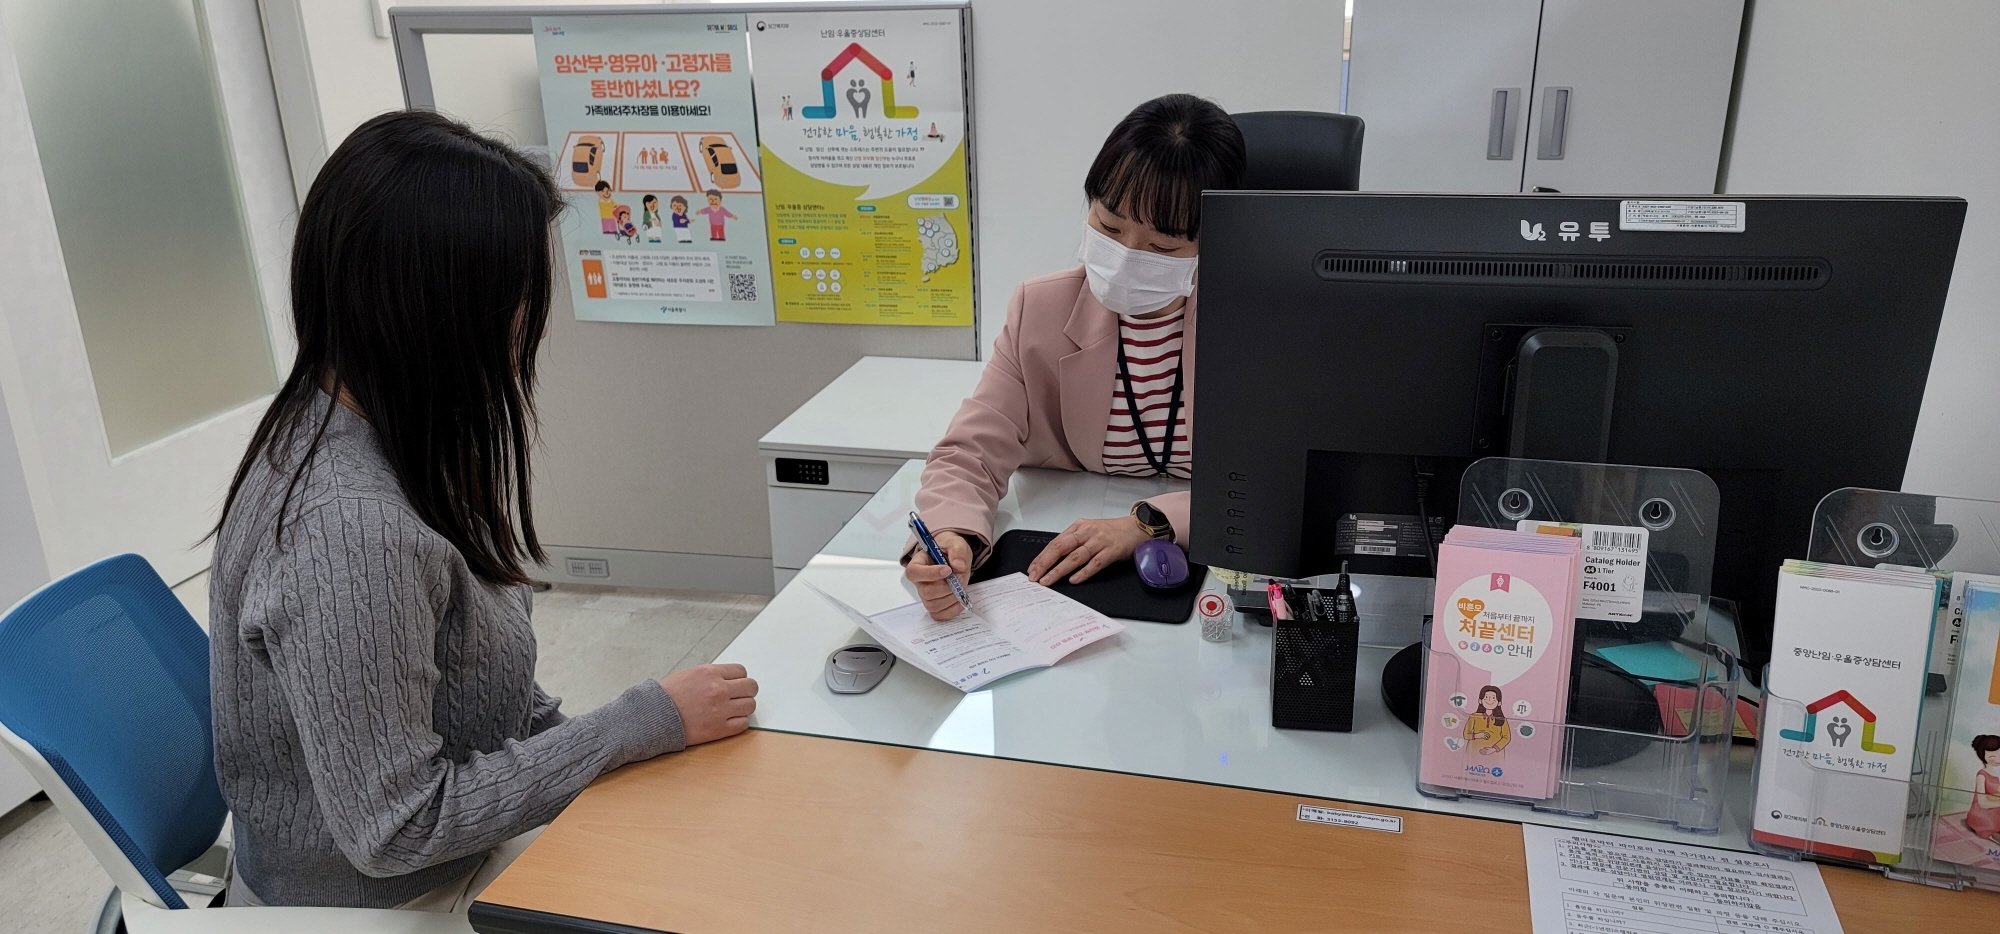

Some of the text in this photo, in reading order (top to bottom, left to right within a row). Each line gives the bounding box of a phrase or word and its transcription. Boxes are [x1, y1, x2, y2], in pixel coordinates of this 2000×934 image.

[554, 53, 658, 73] 임산부·영유아
[590, 80, 700, 98] 동반하셨나요?
[584, 105, 712, 116] 가족배려주차장을 이용하세요!
[802, 125, 918, 142] 건강한 마음, 행복한 가정
[1558, 221, 1611, 242] 유투
[1586, 556, 1641, 566] Catalog Holder
[1583, 581, 1616, 592] F4001
[1483, 611, 1535, 623] 처음부터 끝까지
[1459, 619, 1534, 643] 처끝센터
[1508, 644, 1532, 658] 안내
[1793, 646, 1901, 670] 중앙난임·우울증상담센터
[1783, 748, 1809, 760] 건강한
[1837, 756, 1864, 769] 행복한
[1867, 762, 1887, 773] 가정
[1784, 814, 1808, 823] 보건복지부
